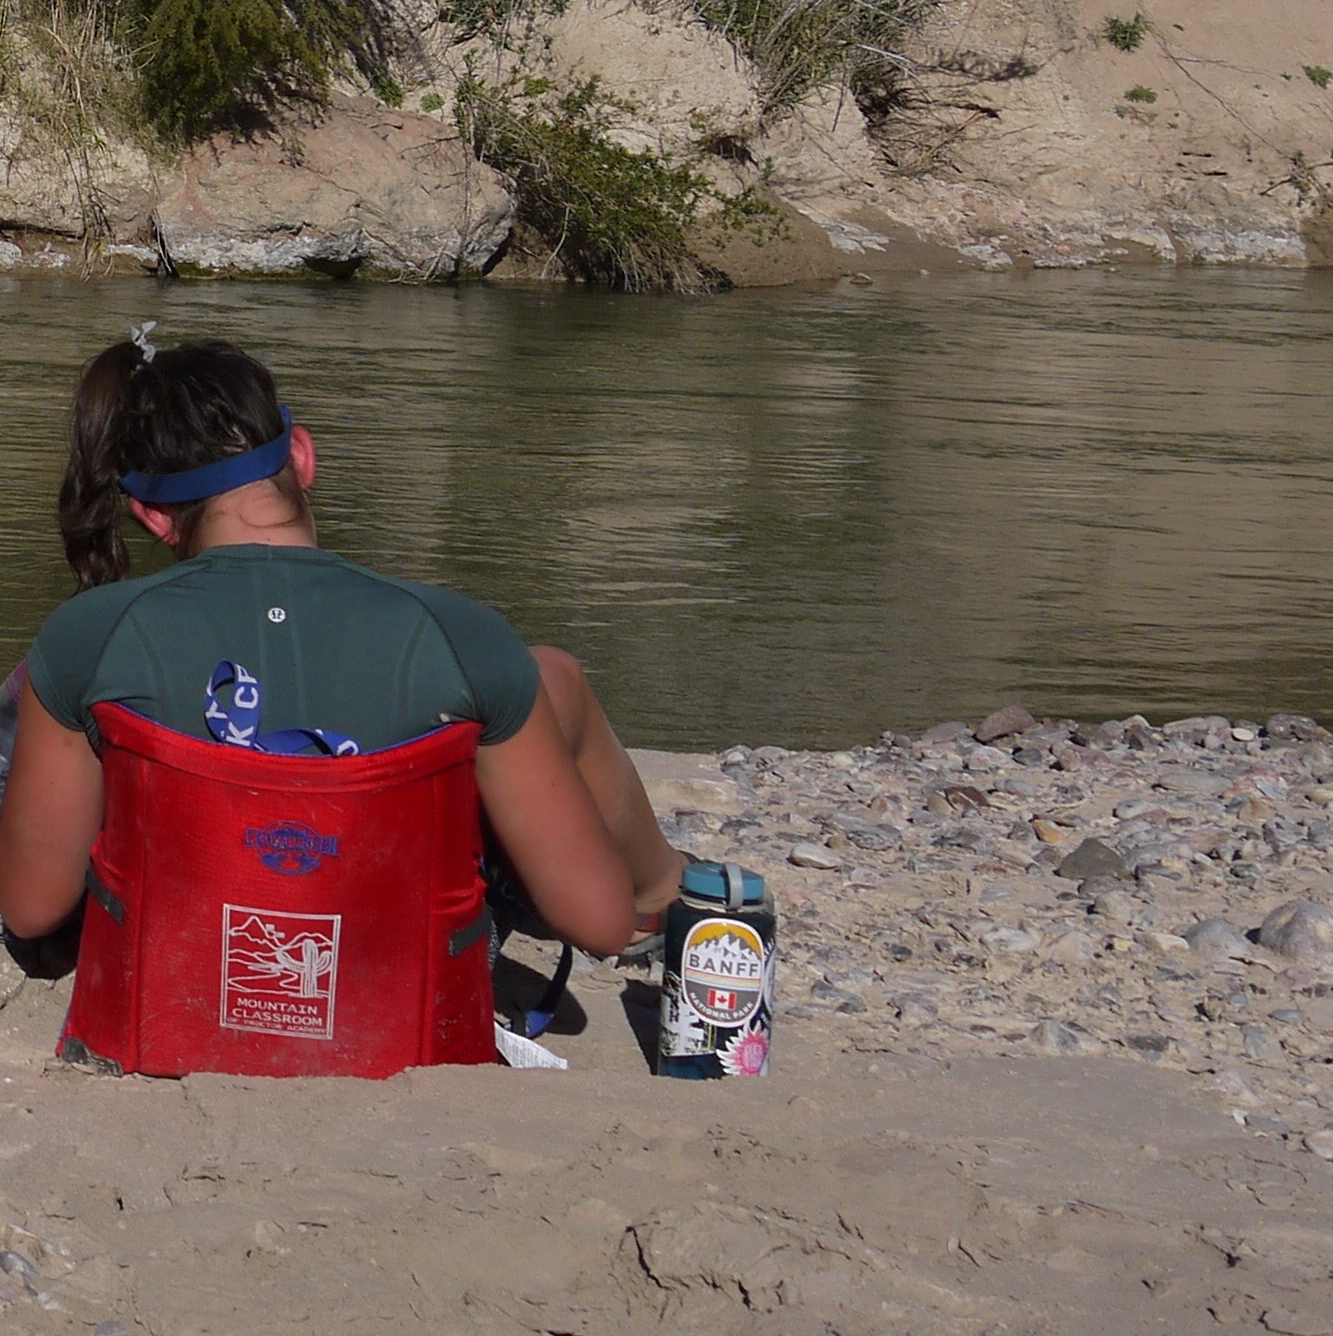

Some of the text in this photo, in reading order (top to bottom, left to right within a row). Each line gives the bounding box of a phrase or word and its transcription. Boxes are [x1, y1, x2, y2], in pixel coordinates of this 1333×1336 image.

[689, 954, 758, 976] BANFF
[237, 997, 318, 1015] MOUNTAIN
[689, 992, 731, 1020] NATIONAL
[733, 1002, 754, 1019] PARK
[232, 1008, 323, 1026] CLASSROOM
